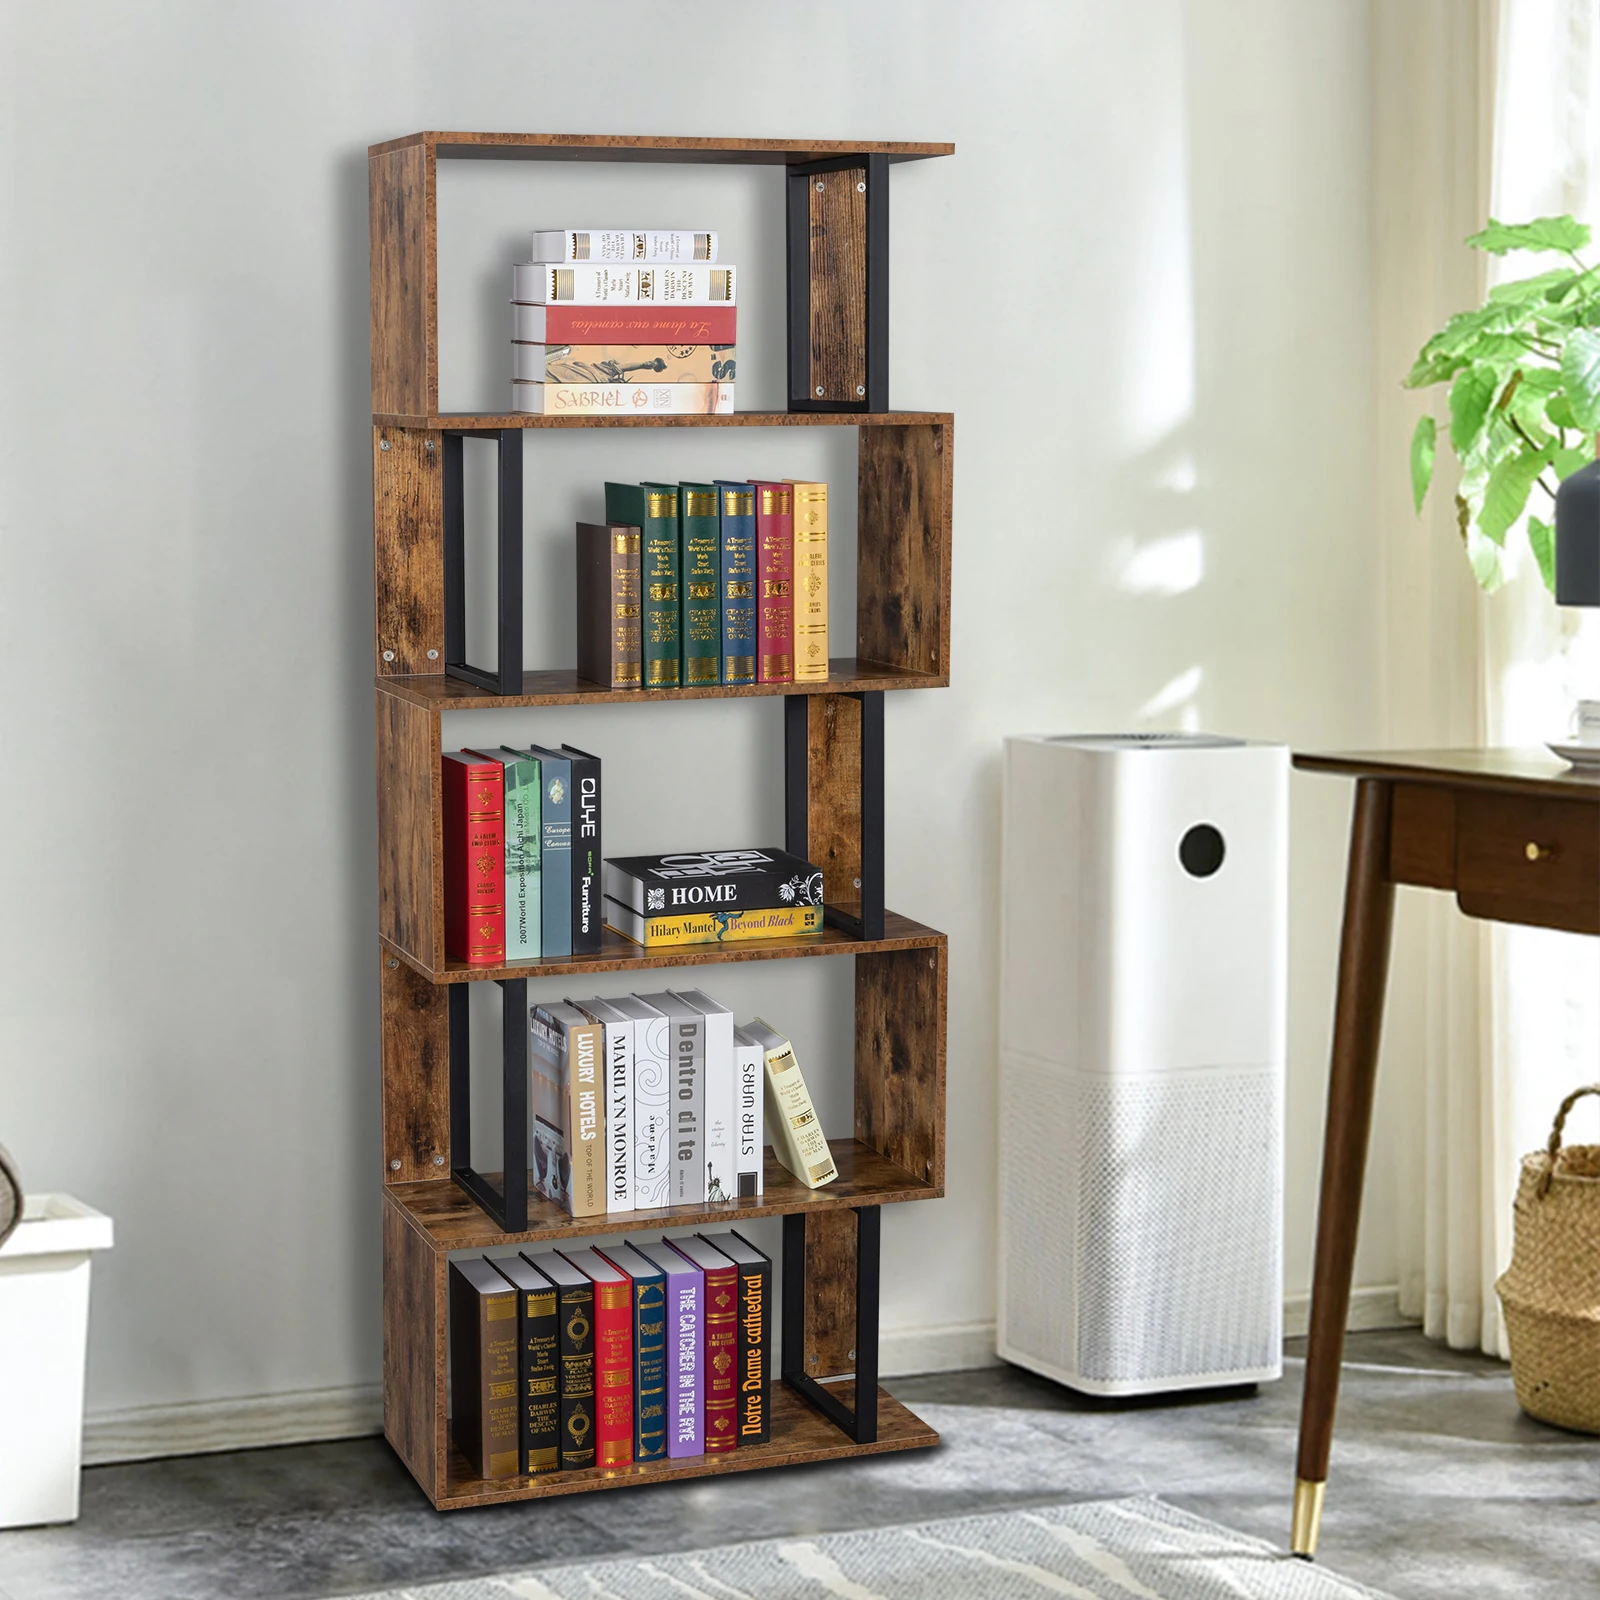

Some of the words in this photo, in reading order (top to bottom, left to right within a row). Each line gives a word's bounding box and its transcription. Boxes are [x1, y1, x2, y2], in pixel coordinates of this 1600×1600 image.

[571, 320, 625, 335] camelias
[653, 321, 687, 335] dame
[516, 803, 524, 829] Japan
[516, 830, 524, 851] Aichi
[517, 854, 526, 898] Exposition
[582, 876, 591, 933] Furniture
[671, 884, 738, 905] HOME
[650, 924, 681, 939] Hilary
[682, 920, 716, 934] Mantel
[730, 918, 766, 933] Beyond
[767, 913, 795, 927] Black
[577, 1033, 595, 1083] LUXURY
[678, 1023, 698, 1101] Dentro
[614, 1035, 626, 1119] MARILYN
[742, 1063, 755, 1109] WARS
[579, 1091, 596, 1141] HOTELS
[742, 1113, 754, 1155] STAR
[588, 1160, 593, 1168] OF
[614, 1122, 627, 1201] MONROE
[680, 1287, 696, 1312] THE
[742, 1274, 762, 1345] cathedral
[679, 1314, 696, 1372] CATCHER
[679, 1374, 695, 1388] IN
[742, 1348, 762, 1392] Dame
[529, 1402, 557, 1411] CHARLES
[530, 1409, 555, 1417] DARWIN
[679, 1390, 695, 1415] THE
[742, 1395, 762, 1436] Notre
[679, 1417, 695, 1443] RYE
